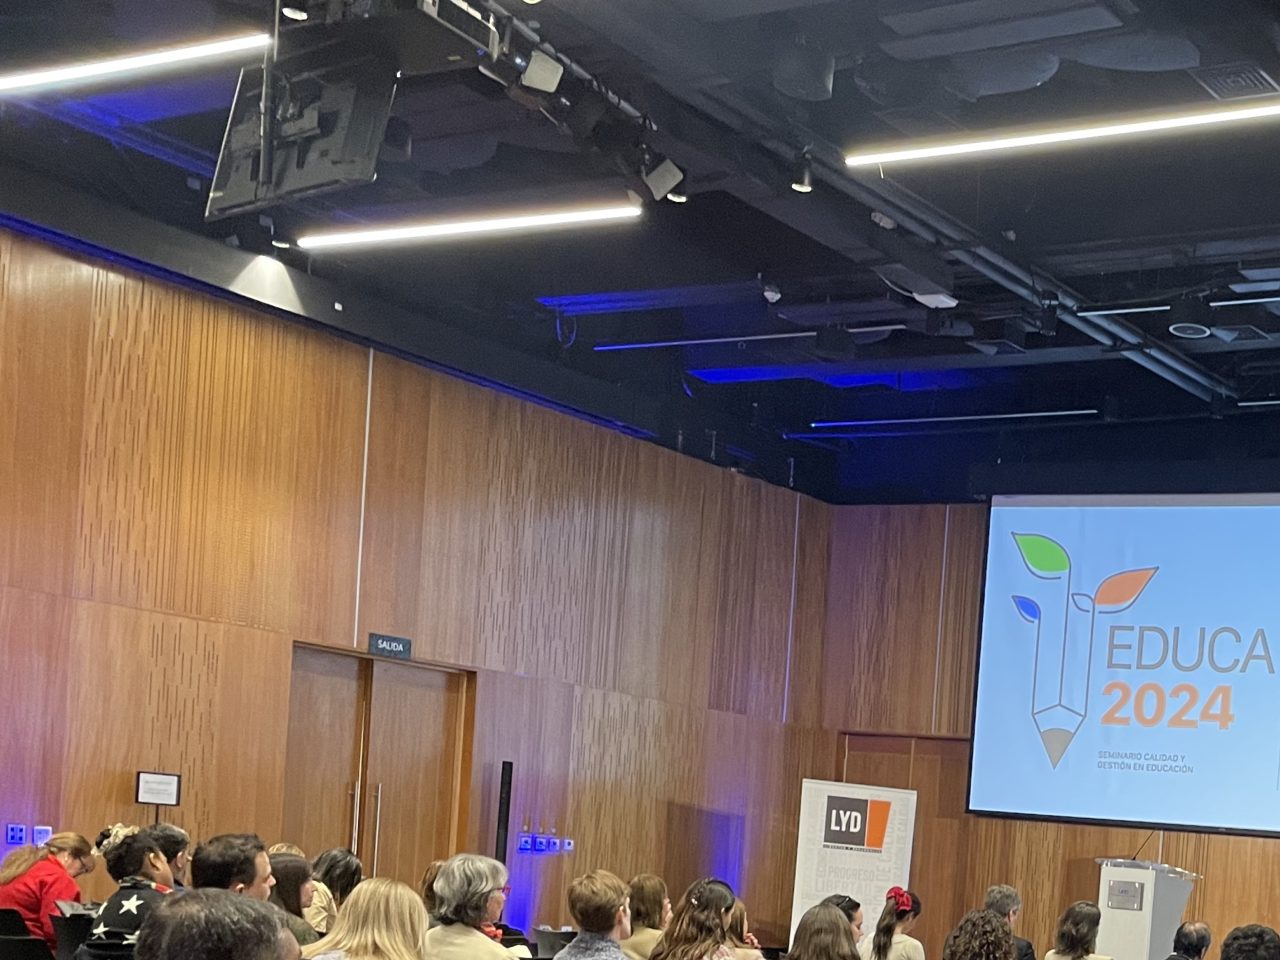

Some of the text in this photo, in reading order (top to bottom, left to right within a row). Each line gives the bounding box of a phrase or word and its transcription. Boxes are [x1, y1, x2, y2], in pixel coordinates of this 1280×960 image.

[378, 640, 404, 652] SALIDA
[1106, 625, 1276, 674] EDUCA
[1100, 681, 1236, 730] 2024
[1098, 750, 1186, 762] SEMINARIO CALIDAD Y
[1097, 760, 1194, 774] GESTIÓN EN EDUCACIÓN
[830, 809, 862, 832] LYD
